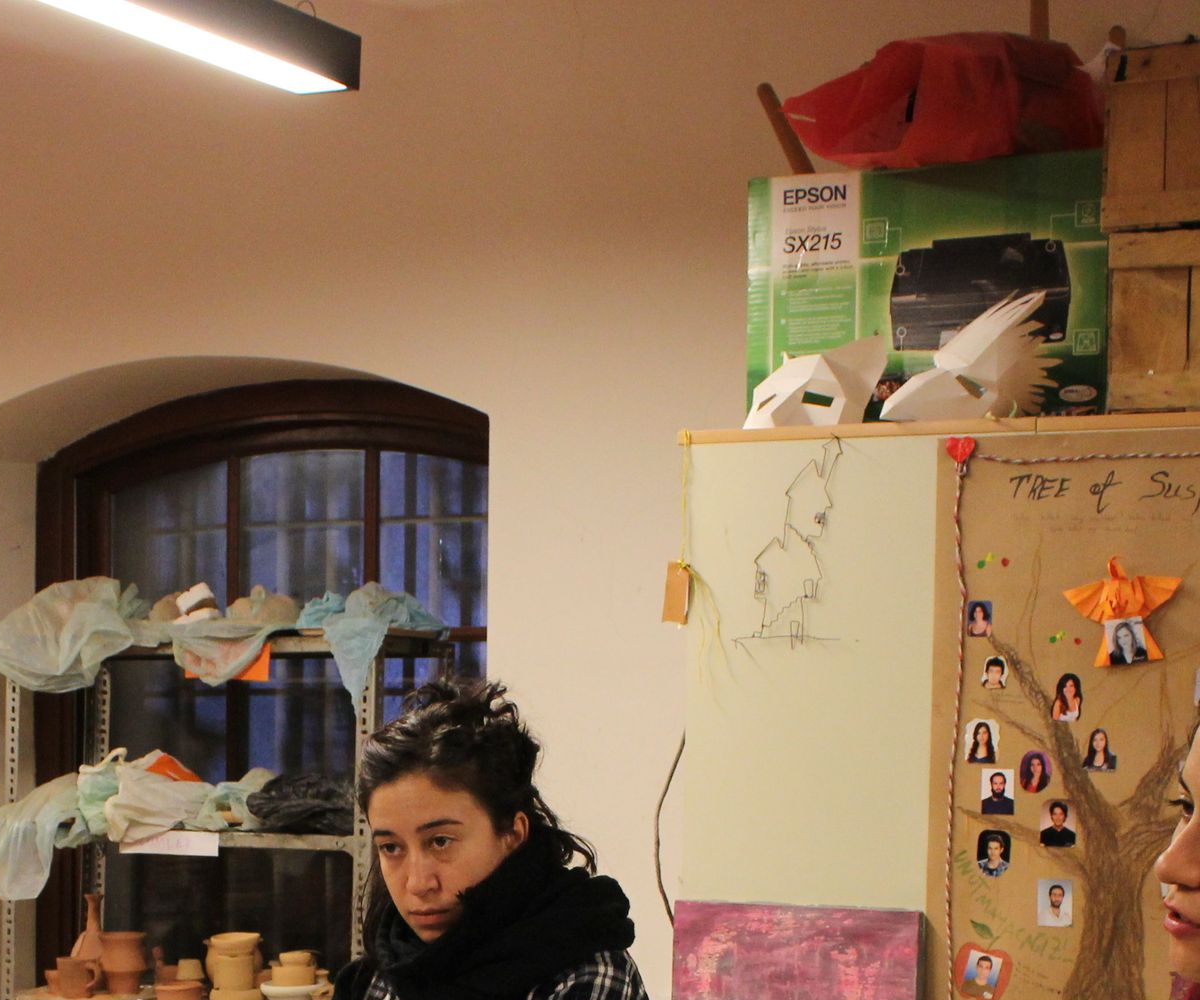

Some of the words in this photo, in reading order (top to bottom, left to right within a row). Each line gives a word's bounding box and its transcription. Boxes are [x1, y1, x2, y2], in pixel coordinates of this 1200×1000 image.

[783, 184, 847, 206] EPSON
[783, 232, 842, 254] SX215
[1009, 473, 1072, 501] TREE
[1088, 470, 1123, 514] of
[1137, 470, 1200, 516] Sus
